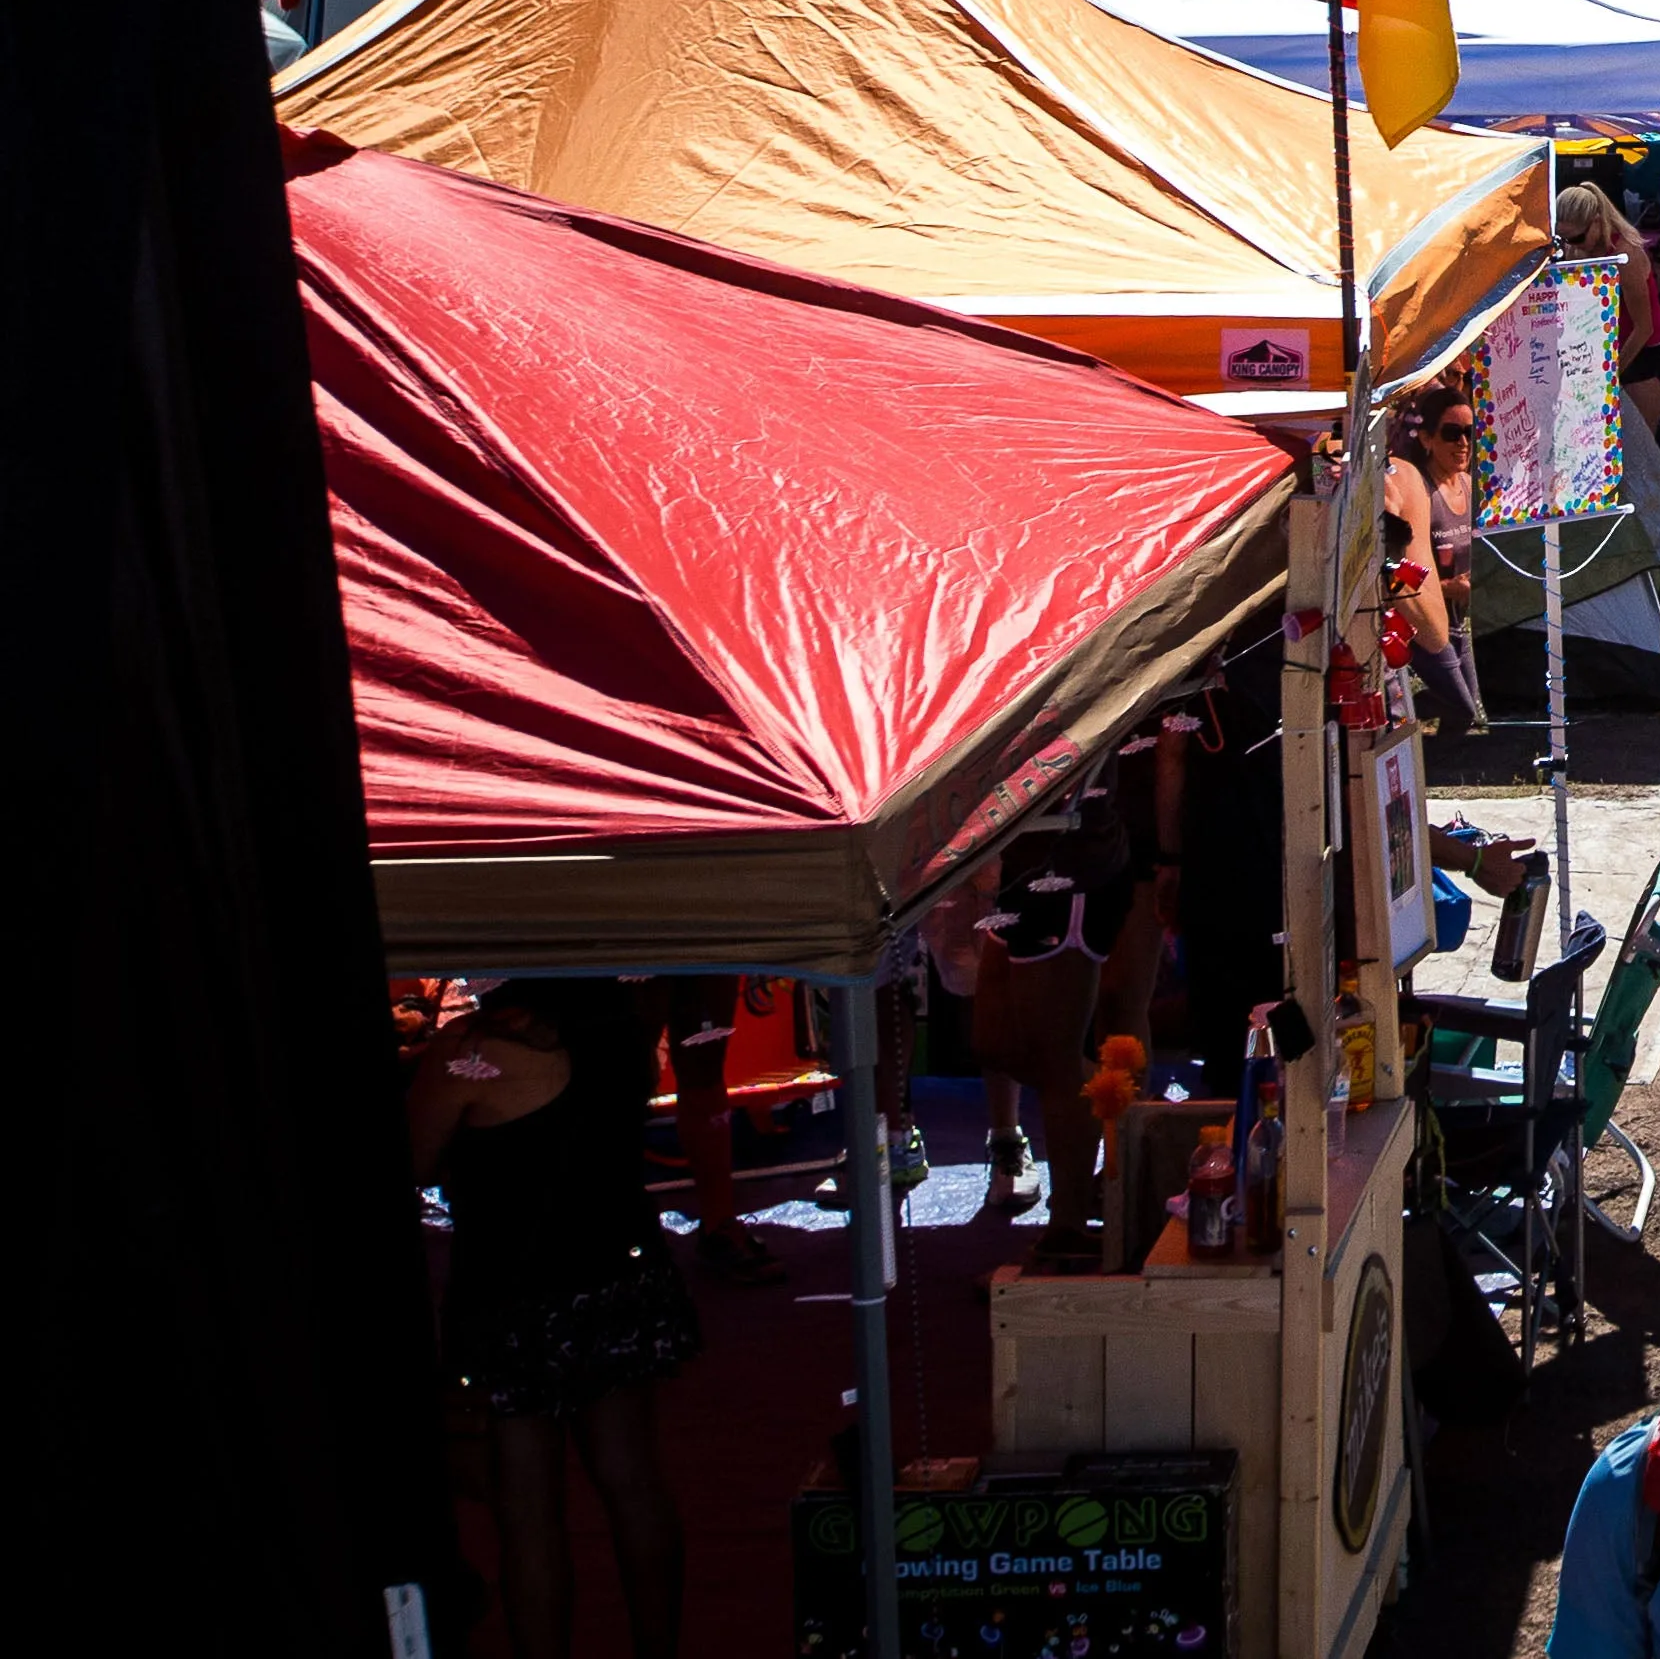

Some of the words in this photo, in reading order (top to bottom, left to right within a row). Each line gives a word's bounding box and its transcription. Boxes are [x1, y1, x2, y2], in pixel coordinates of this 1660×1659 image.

[1528, 291, 1559, 303] HAPPY
[1521, 301, 1569, 317] BIRTHDAY!
[1231, 363, 1257, 375] KING
[1258, 363, 1300, 375] CANOPY
[808, 1493, 1209, 1555] GOWPONG
[989, 1552, 1074, 1575] Game
[1084, 1548, 1162, 1572] Table
[897, 1585, 986, 1603] ompetition
[1075, 1581, 1100, 1593] Ice
[1105, 1579, 1143, 1593] Blue
